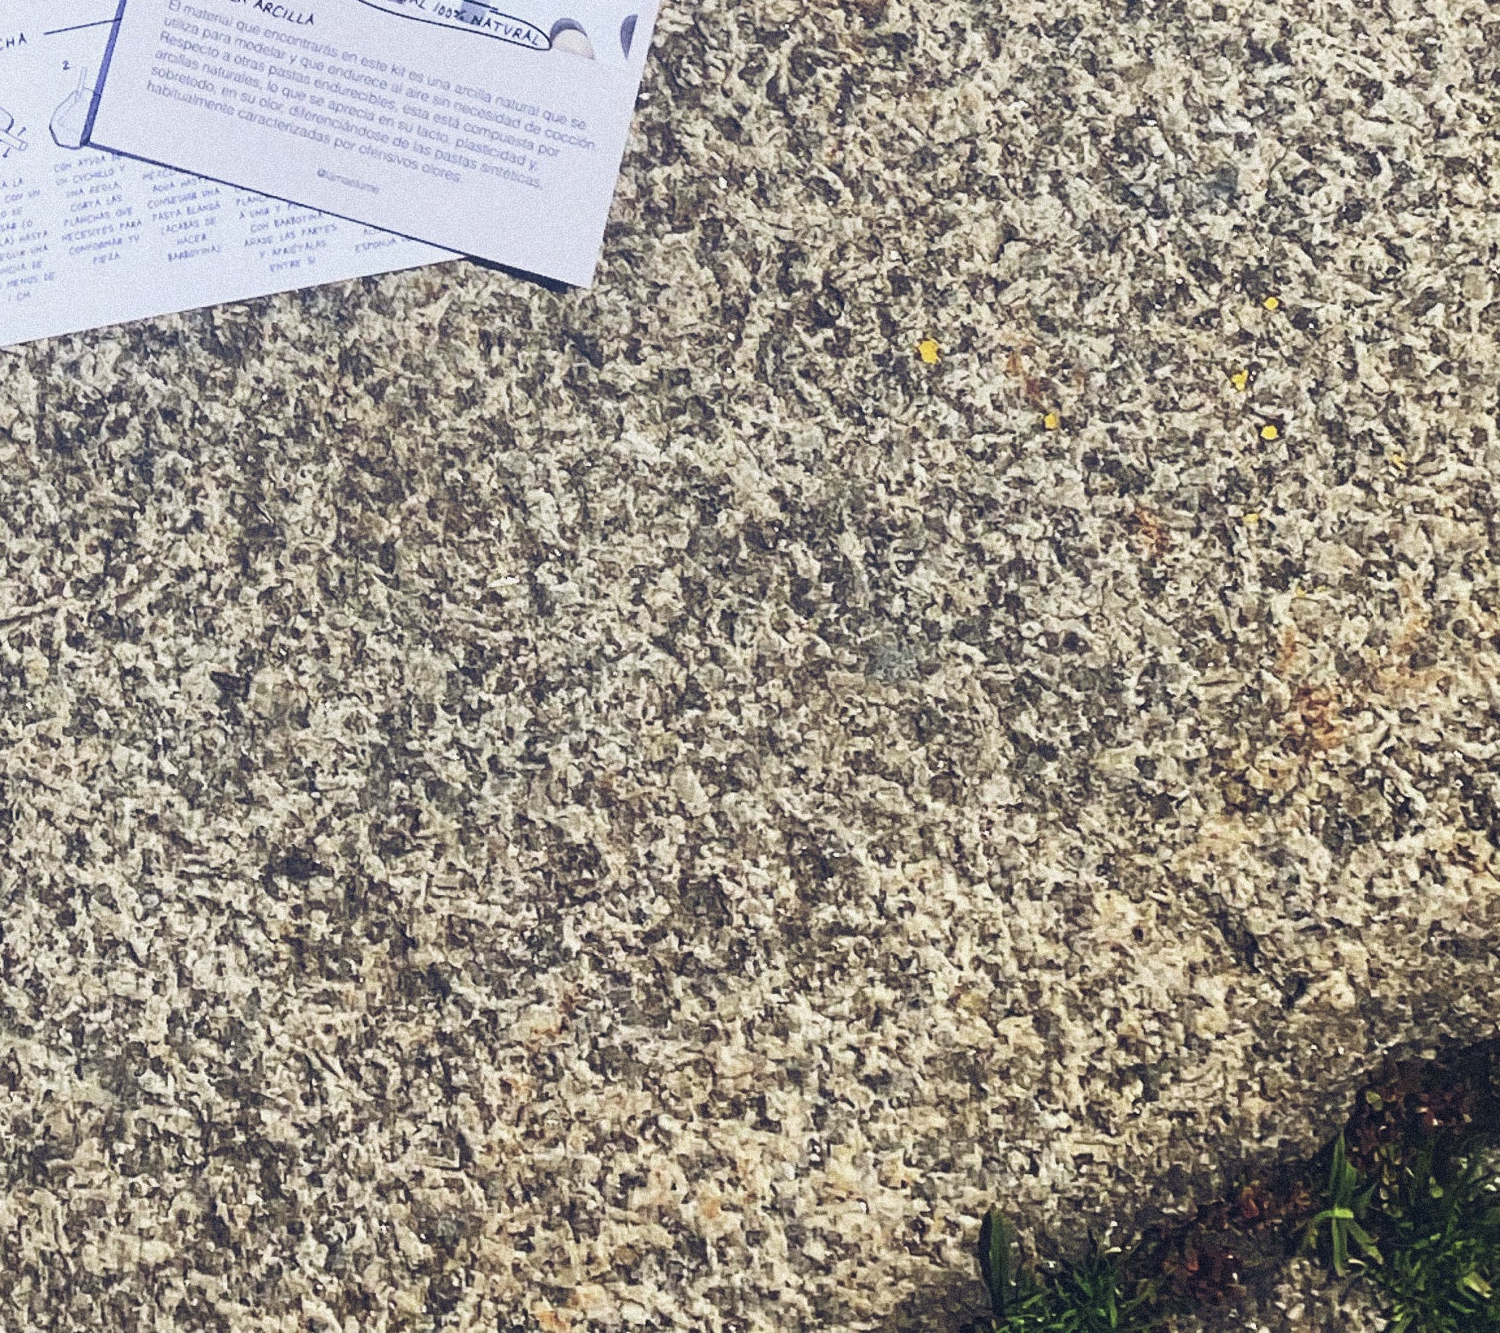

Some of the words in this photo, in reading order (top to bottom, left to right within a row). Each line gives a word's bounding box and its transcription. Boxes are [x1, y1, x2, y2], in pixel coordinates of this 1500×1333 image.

[432, 0, 467, 22] 100%
[61, 59, 71, 71] 2
[154, 49, 198, 70] arcillas
[266, 80, 278, 93] lo
[281, 86, 306, 101] que
[309, 95, 324, 106] se
[327, 100, 375, 121] aprecia
[378, 115, 394, 126] en
[397, 120, 413, 133] su
[454, 138, 526, 166] plasticidad
[159, 29, 219, 58] Respecto
[221, 51, 230, 62] a
[233, 54, 264, 71] otras
[267, 64, 310, 84] pastas
[402, 104, 429, 120] esta
[432, 113, 460, 129] está
[462, 122, 534, 150] compuesta
[536, 143, 560, 157] por
[163, 17, 199, 35] utiliza
[201, 28, 231, 44] para
[234, 37, 286, 59] modelar
[289, 55, 297, 65] y
[299, 56, 324, 71] que
[327, 65, 387, 89] endurece
[390, 83, 402, 93] al
[405, 87, 429, 101] aire
[432, 95, 450, 107] sin
[453, 101, 521, 128] necesidad
[523, 121, 541, 135] de
[182, 5, 233, 26] material
[235, 20, 260, 35] que
[262, 28, 338, 57] encontrarás
[341, 51, 357, 62] en
[360, 56, 388, 72] este
[390, 63, 406, 77] kit
[408, 70, 424, 83] es
[426, 76, 451, 91] una
[453, 84, 492, 103] arcilla
[495, 96, 539, 116] natural
[541, 109, 567, 124] que
[570, 117, 586, 130] se
[145, 79, 234, 115] habitualmente
[236, 109, 330, 144] caracterizadas
[333, 137, 355, 150] por
[358, 144, 418, 169] ofensivos
[220, 86, 237, 97] en
[240, 92, 256, 104] su
[288, 105, 389, 143] diferenciándose
[391, 136, 409, 149] de
[412, 140, 431, 156] las
[434, 148, 476, 169] pastas
